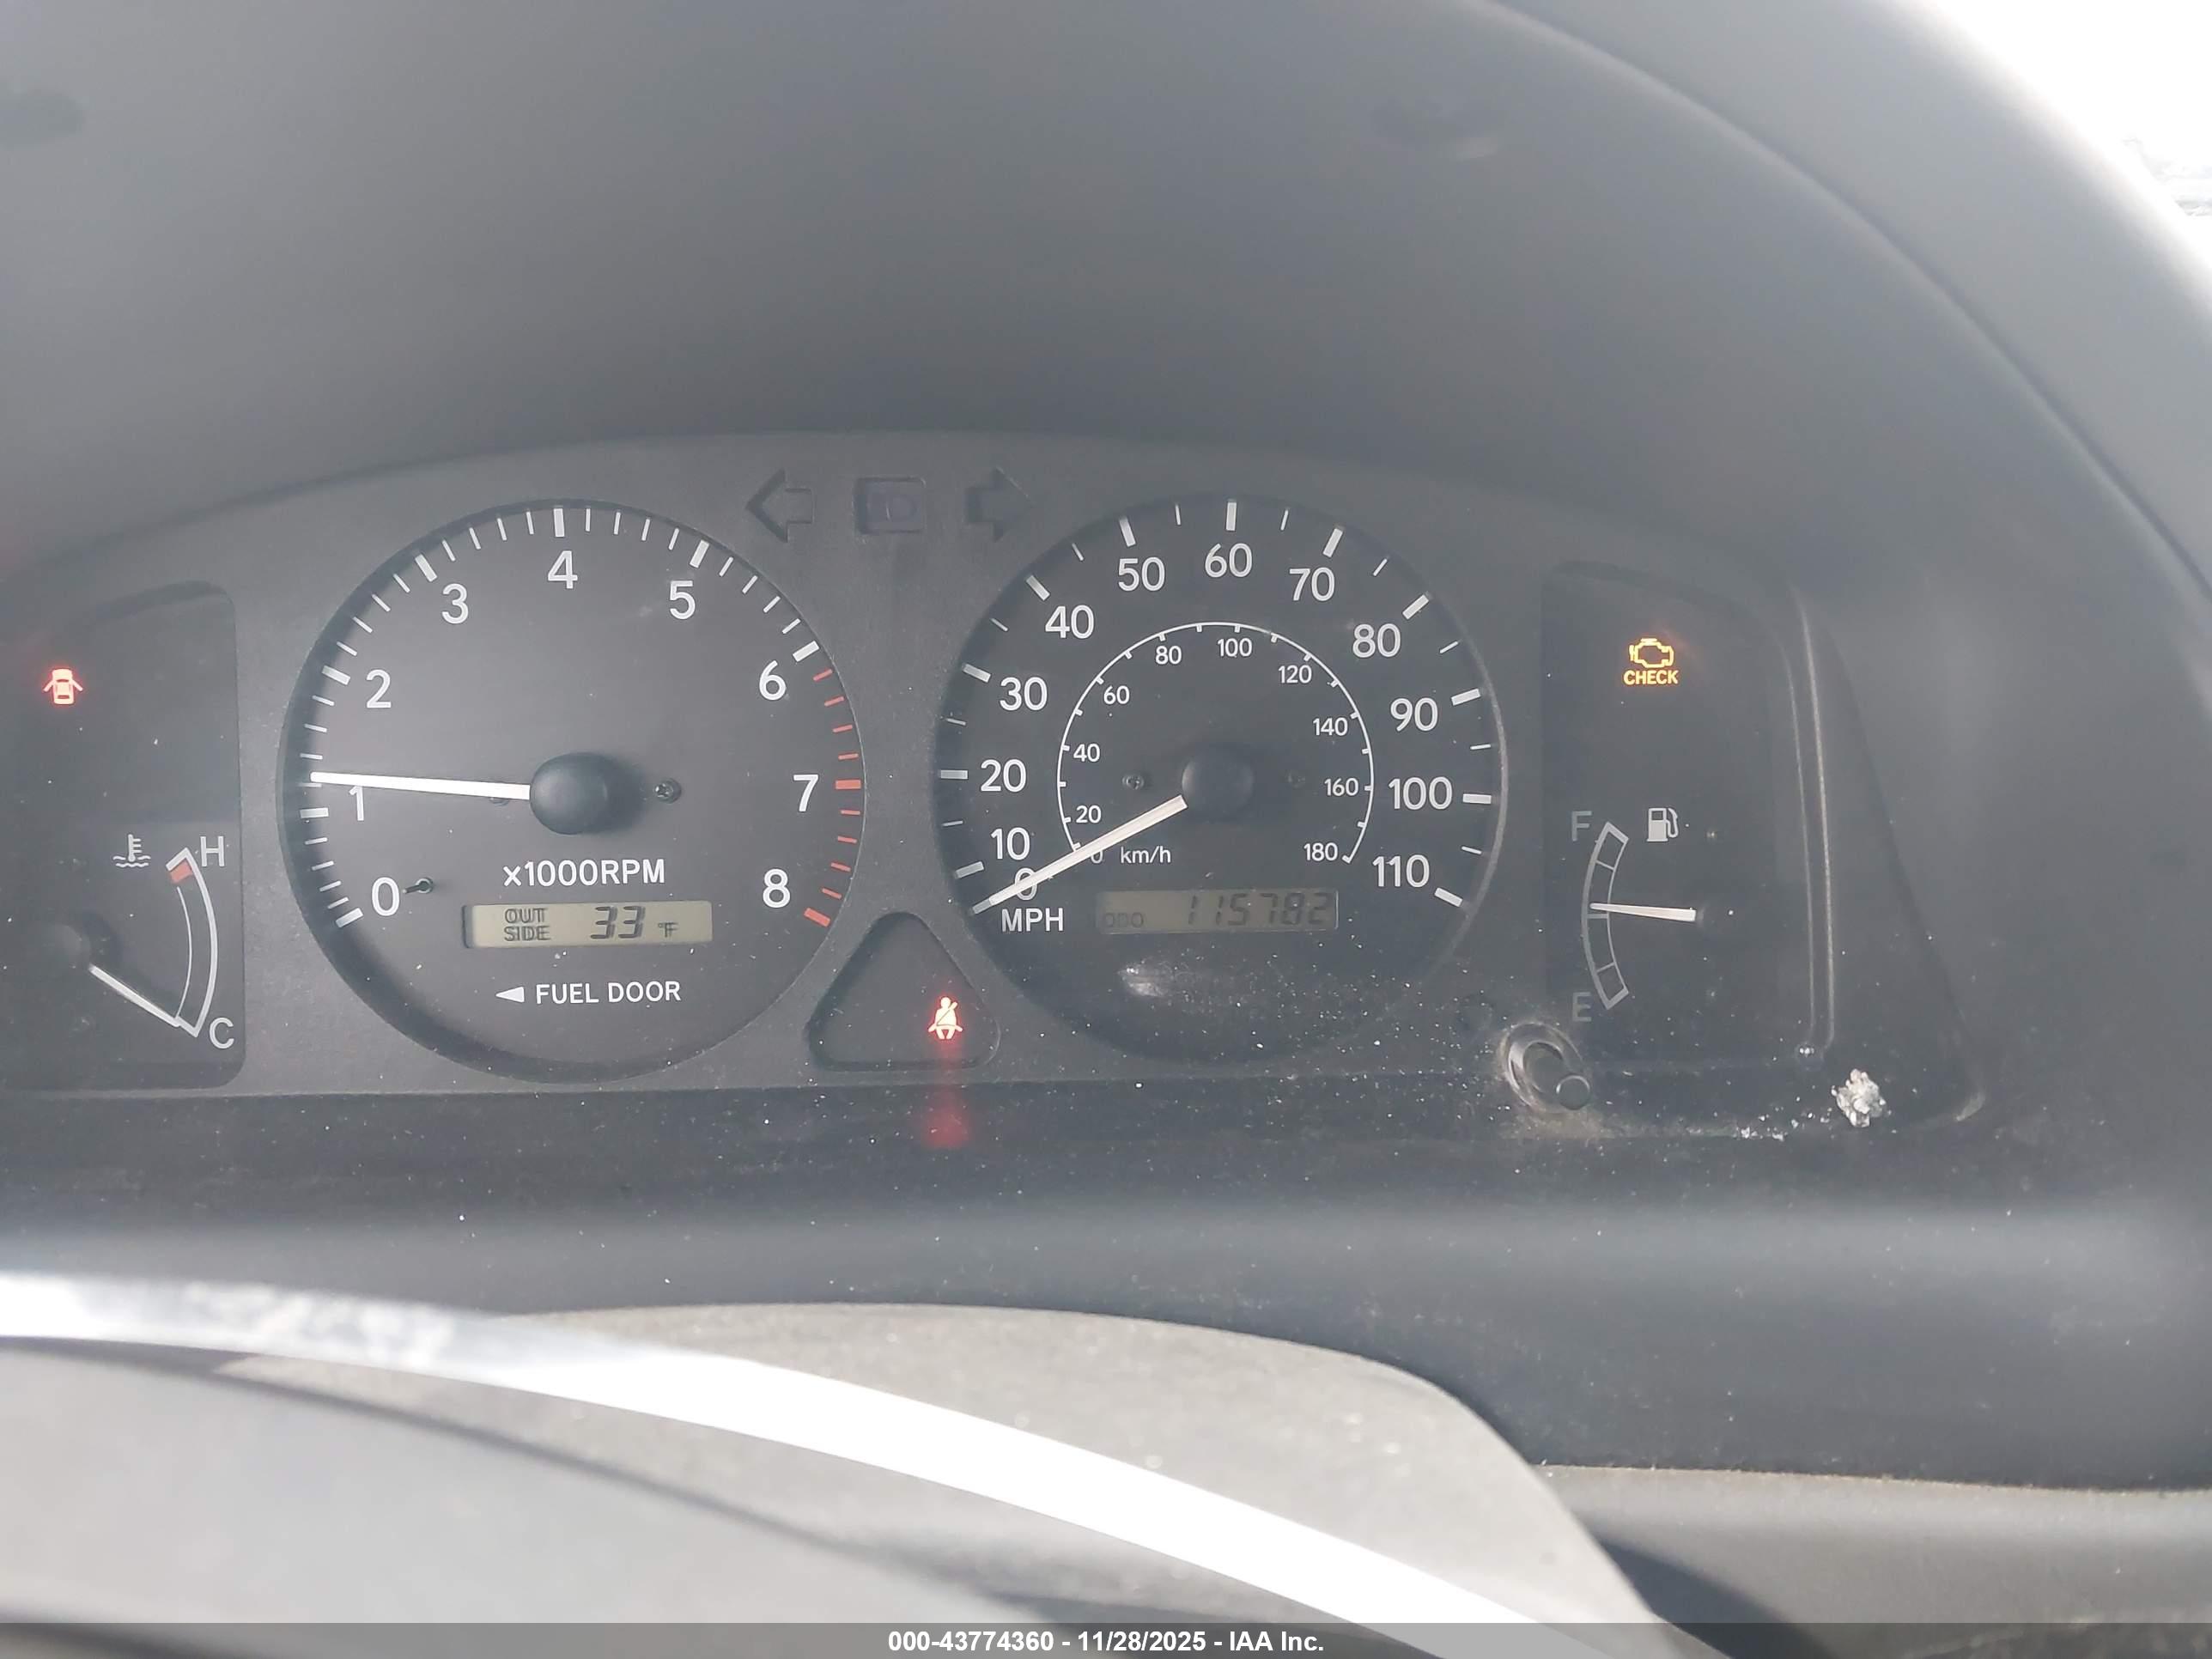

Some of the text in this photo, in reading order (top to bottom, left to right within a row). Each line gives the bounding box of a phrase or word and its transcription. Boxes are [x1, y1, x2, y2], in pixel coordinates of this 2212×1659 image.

[547, 550, 578, 589] 4
[1118, 556, 1165, 592] 50
[1205, 543, 1253, 578] 60
[670, 580, 696, 620] 5
[1289, 567, 1335, 602] 70
[441, 583, 469, 624] 3
[1045, 605, 1094, 639] 40
[1155, 645, 1182, 665] 80
[1217, 637, 1253, 658] 100
[1352, 623, 1401, 658] 80
[366, 669, 392, 708] 2
[759, 659, 787, 701] 6
[1278, 665, 1312, 684] 120
[1623, 669, 1679, 685] CHECK
[1000, 677, 1048, 711] 30
[1103, 685, 1130, 705] 60
[1313, 717, 1348, 736] 140
[1390, 697, 1438, 732] 90
[1073, 743, 1101, 763] 40
[981, 758, 1027, 793] 20
[1324, 777, 1359, 797] 160
[349, 781, 364, 821] 1
[793, 774, 819, 812] 7
[1388, 776, 1453, 811] 100
[1076, 805, 1102, 823] 20
[1571, 810, 1592, 842] F
[200, 836, 225, 867] H
[991, 827, 1030, 860] 10
[1121, 845, 1171, 864] km/h
[1304, 842, 1338, 861] 180
[502, 859, 665, 887] x1000RPM
[1014, 867, 1038, 901] 0
[1372, 854, 1430, 888] 110
[371, 877, 400, 916] 0
[763, 868, 791, 908] 8
[504, 907, 548, 924] OUT
[591, 906, 645, 939] 33
[1001, 907, 1063, 932] MPH
[1188, 892, 1329, 927] 115782
[504, 925, 550, 942] SIDE
[536, 981, 681, 1005] FUEL DOOR
[1571, 991, 1592, 1023] E
[209, 1017, 234, 1049] C
